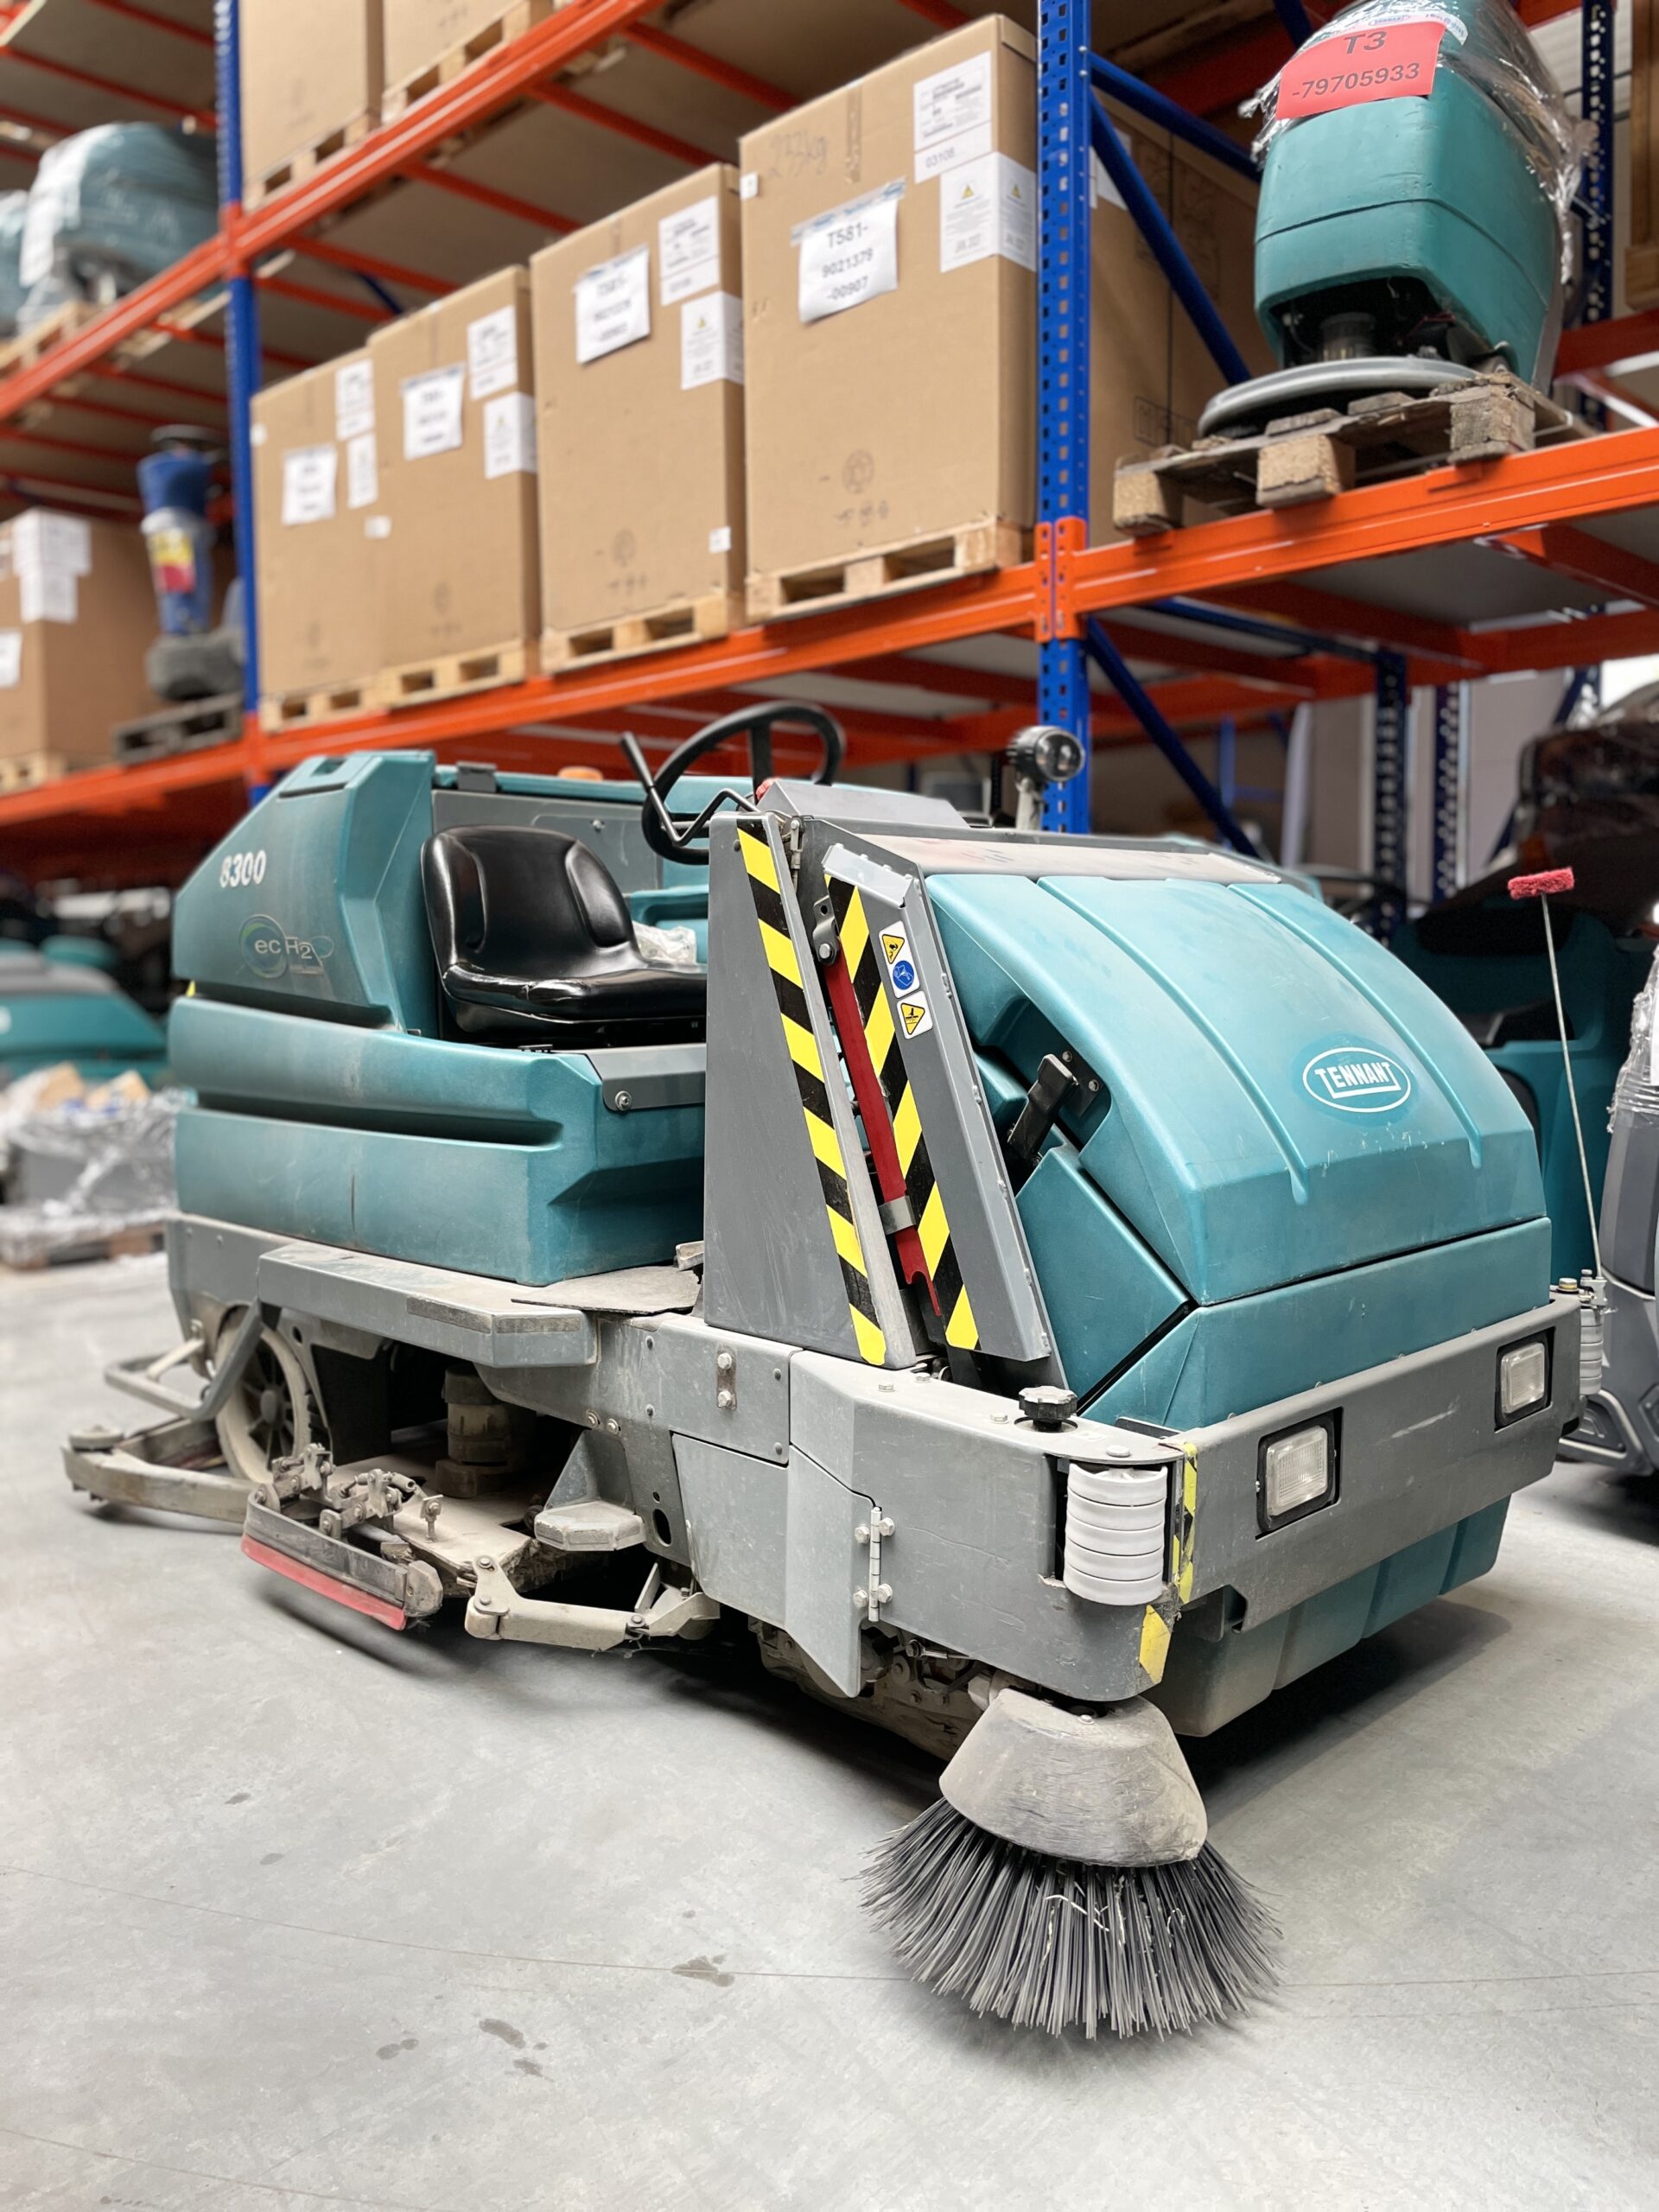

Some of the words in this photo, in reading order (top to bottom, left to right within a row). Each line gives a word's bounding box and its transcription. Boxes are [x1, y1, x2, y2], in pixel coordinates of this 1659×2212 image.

[1344, 31, 1387, 54] T3
[1292, 62, 1420, 99] -79705933
[219, 849, 267, 888] 8300
[1314, 1062, 1402, 1099] TENNANT
